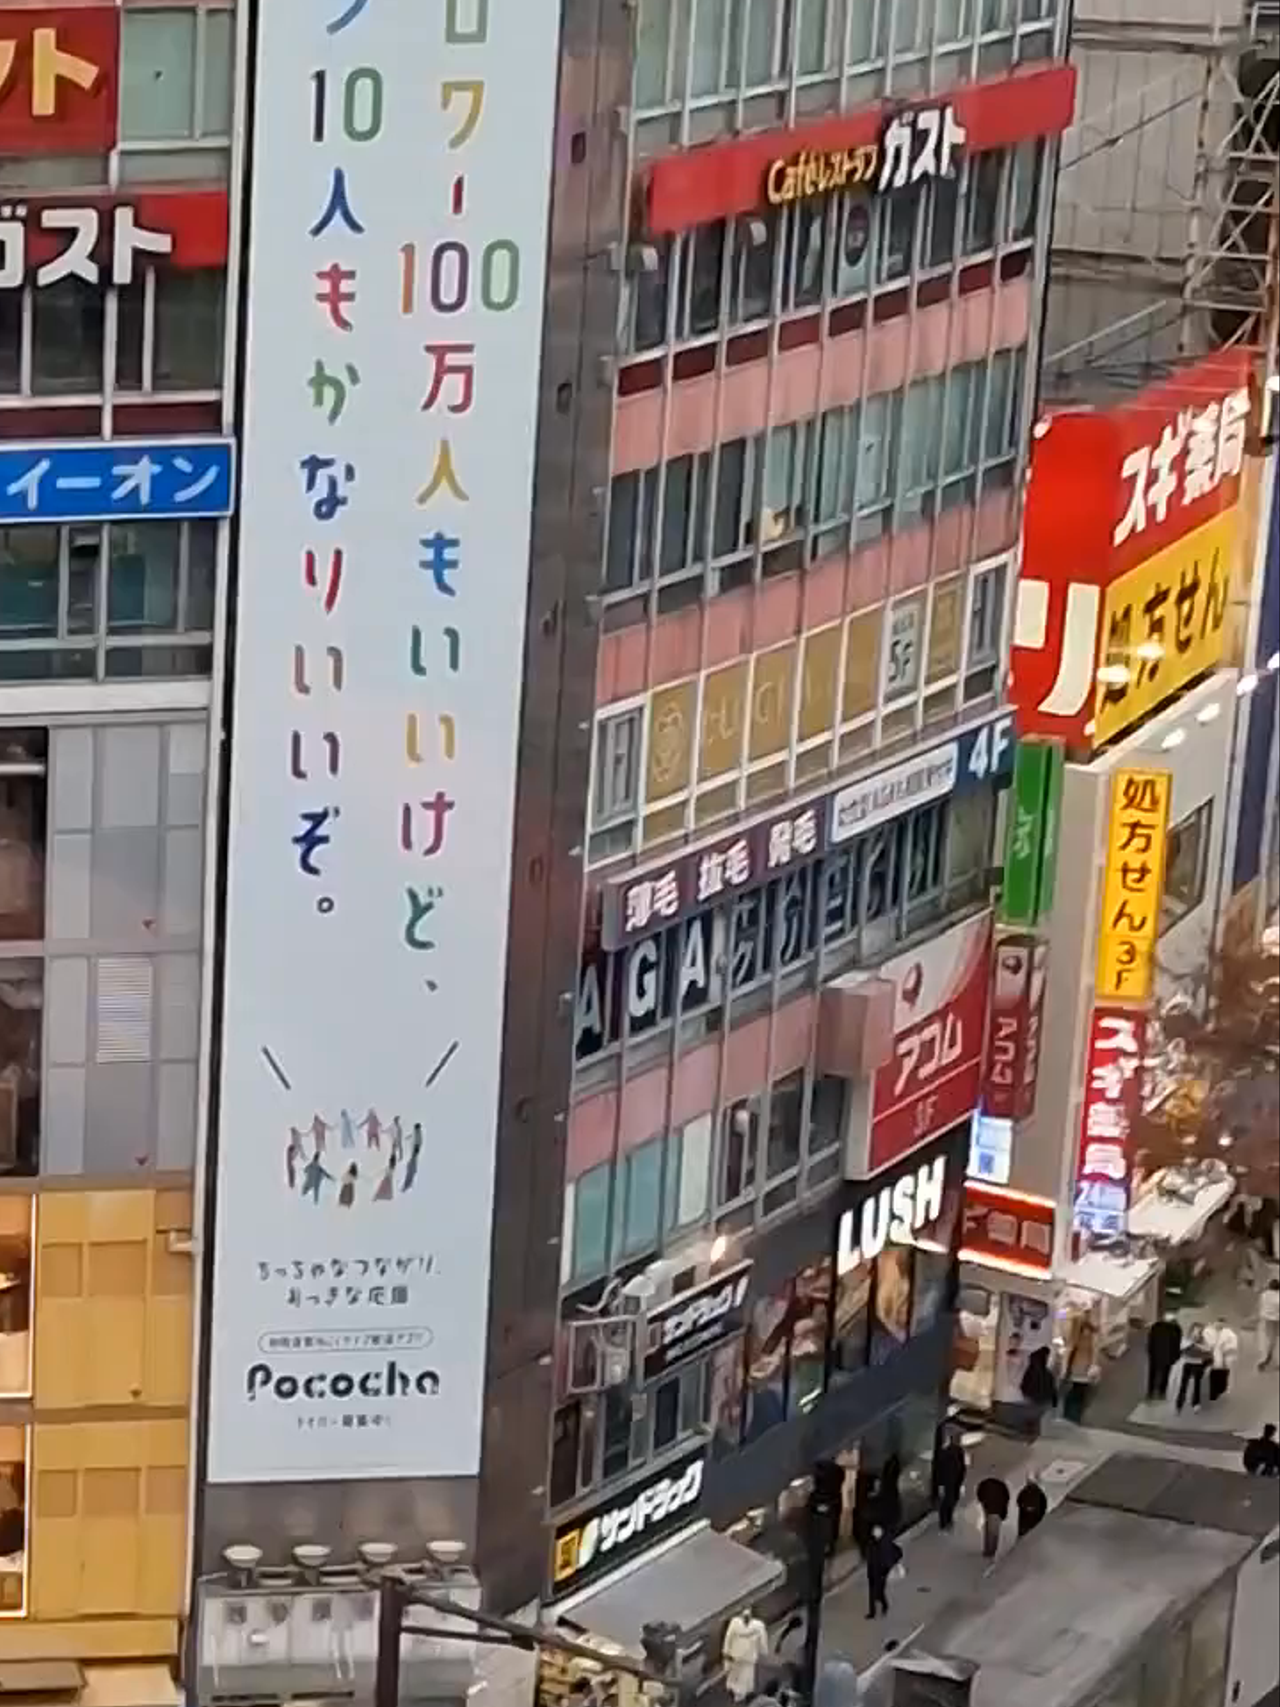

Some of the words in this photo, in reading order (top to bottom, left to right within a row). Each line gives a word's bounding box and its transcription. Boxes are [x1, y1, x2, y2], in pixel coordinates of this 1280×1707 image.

[878, 104, 966, 191] ガスト
[1112, 386, 1252, 548] スギ薬局
[967, 716, 1014, 780] 4F
[1112, 774, 1162, 935] 処方せん
[893, 1011, 965, 1097] アコム
[837, 1155, 947, 1274] LUSH
[245, 1360, 442, 1402] Pococha
